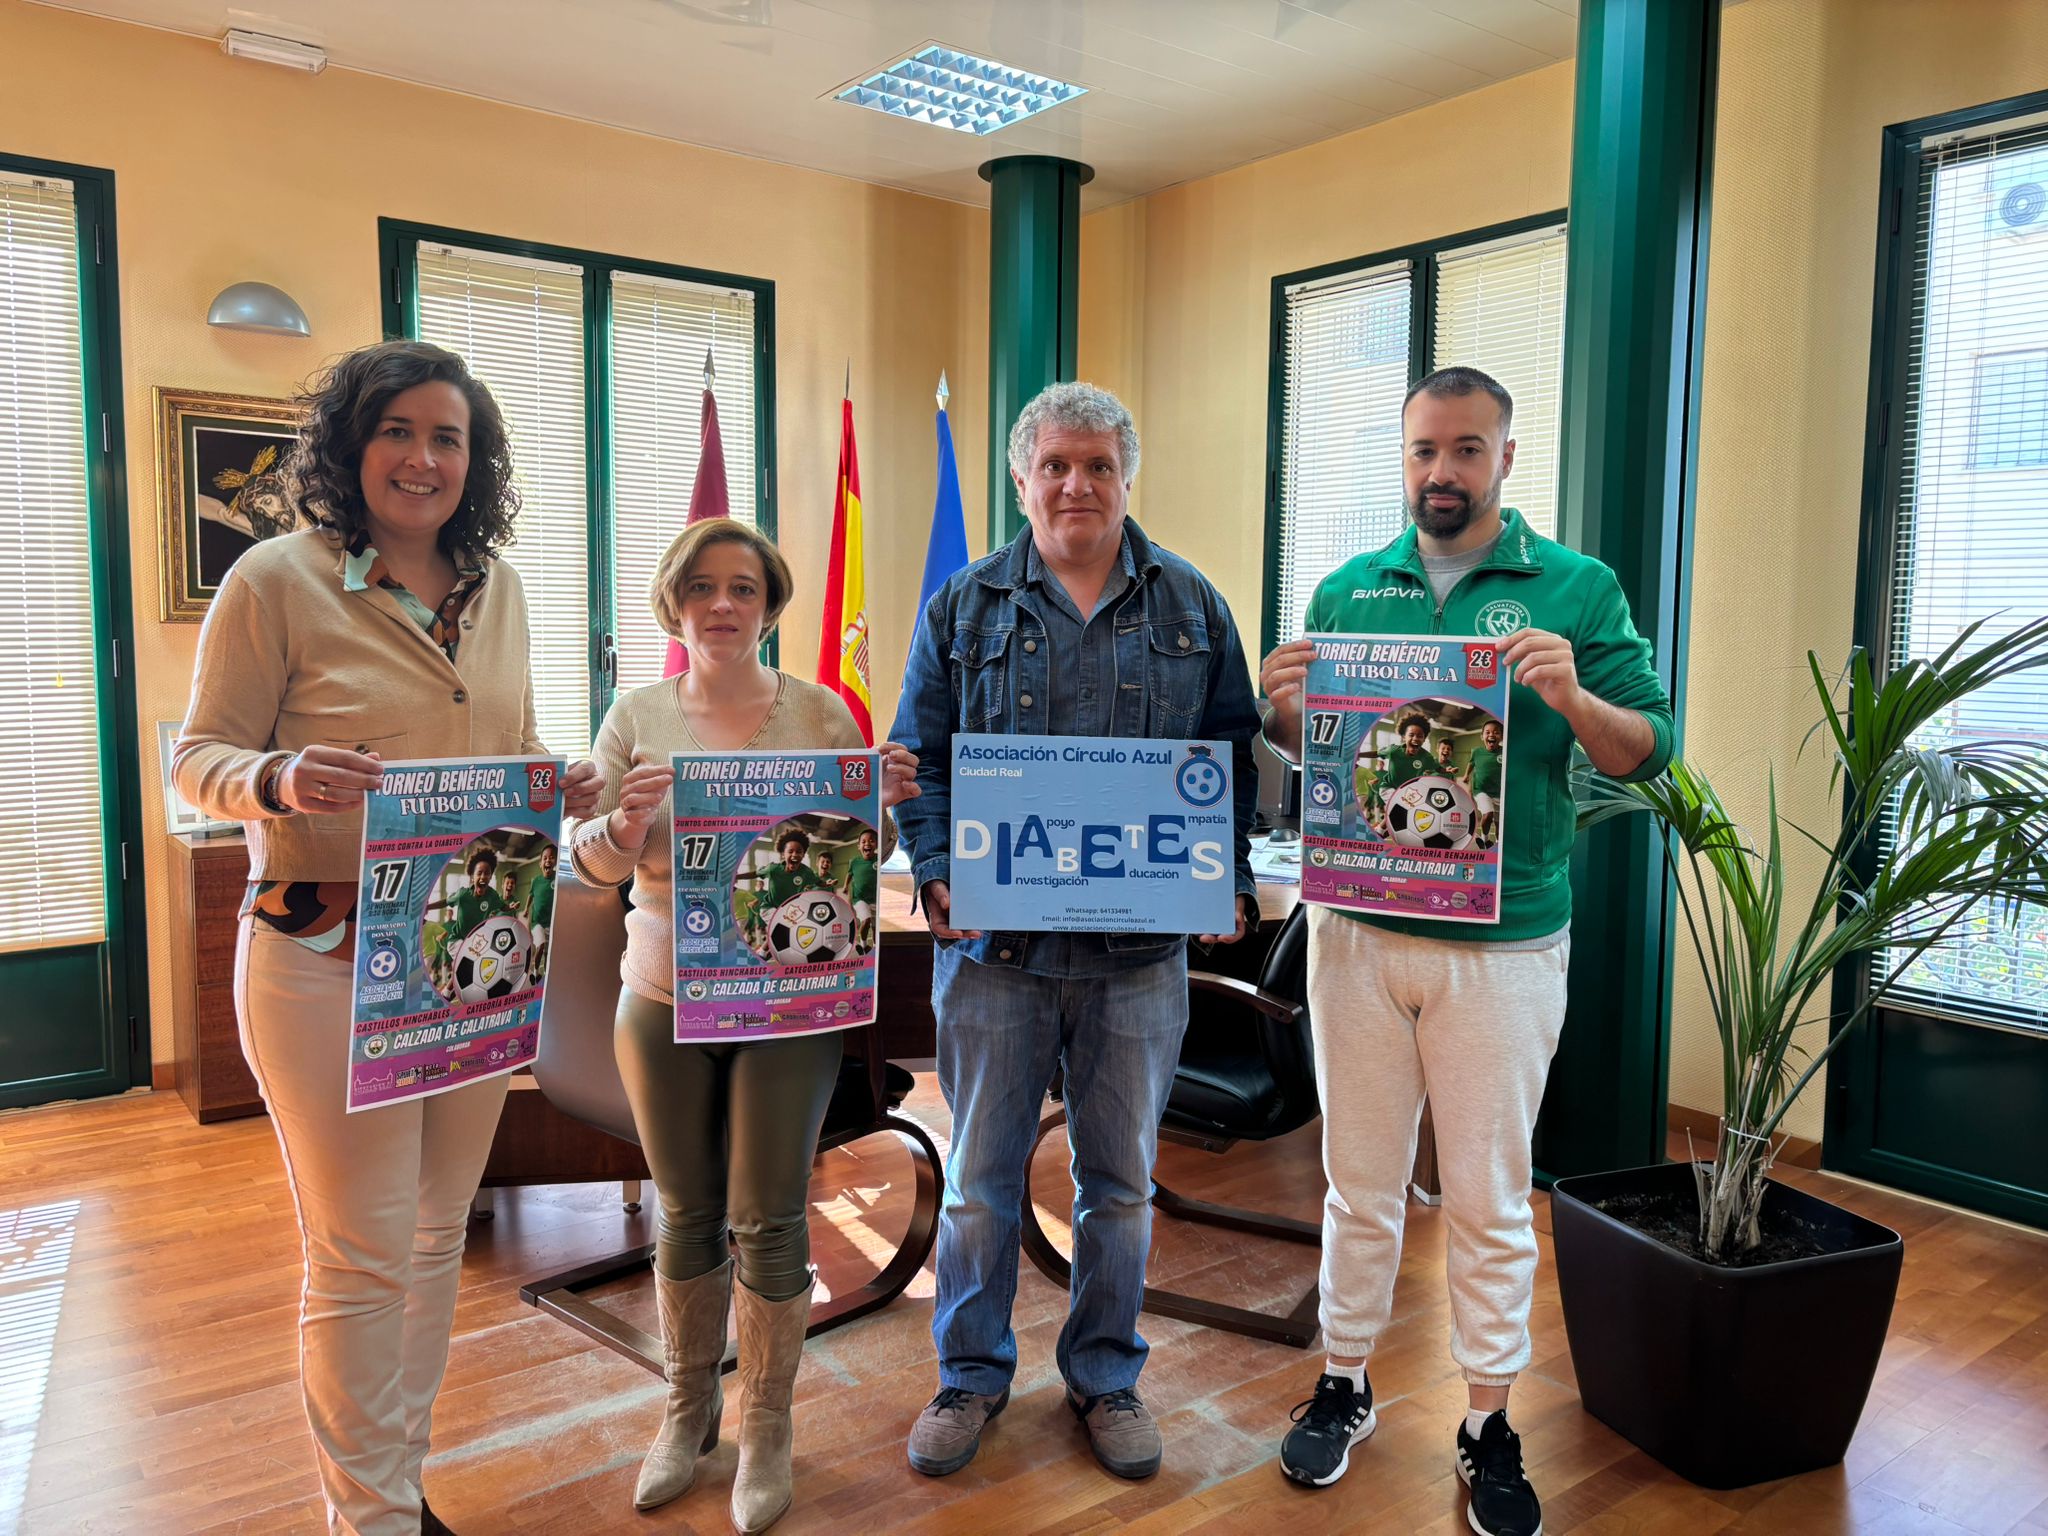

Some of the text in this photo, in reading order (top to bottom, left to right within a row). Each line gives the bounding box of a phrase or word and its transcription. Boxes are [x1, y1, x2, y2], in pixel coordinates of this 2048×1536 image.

[1352, 586, 1425, 599] GIVOVA
[1315, 641, 1441, 664] TORNEO BENÉFICO
[1469, 649, 1493, 669] 2€
[1407, 665, 1459, 682] SALA
[1331, 698, 1354, 706] CONTRA
[1364, 700, 1393, 708] DIABETES
[1310, 711, 1342, 745] 17
[958, 744, 1173, 765] Asociación Círculo Azul
[681, 757, 816, 781] TORNEO BENÉFICO
[844, 761, 866, 780] 2€
[959, 766, 1023, 778] Ciudad Real
[438, 765, 506, 793] BENÉFICO
[530, 769, 552, 790] 2€
[783, 780, 835, 797] SALA
[476, 791, 522, 810] SALA
[675, 820, 702, 828] JUNTOS
[730, 819, 739, 827] LA
[740, 818, 770, 826] DIABETES
[366, 837, 464, 852] JUNTOS CONTRA LA DIABETES
[680, 834, 716, 870] 17
[1303, 836, 1385, 852] CASTILLOS HINCHABLES
[1400, 847, 1486, 862] CATEGORÍA BENJAMÍN
[1332, 853, 1377, 870] CALZADA
[1379, 858, 1393, 871] DE
[1394, 859, 1456, 876] CALATRAVA
[371, 860, 410, 902] 17
[1065, 906, 1099, 916] Whatsapp:
[678, 966, 768, 978] CASTILLOS HINCHABLES
[784, 958, 865, 976] CATEGORÍA BENJAMÍN
[712, 981, 760, 997] CALZADA
[762, 980, 777, 994] DE
[779, 974, 839, 993] CALATRAVA
[466, 990, 536, 1015] CATEGORÍA BENJAMÍN
[356, 1008, 450, 1034] CASTILLOS HINCHABLES
[393, 1024, 444, 1050] CALZADA
[444, 1024, 458, 1039] DE
[460, 1009, 514, 1036] CALATRAVA
